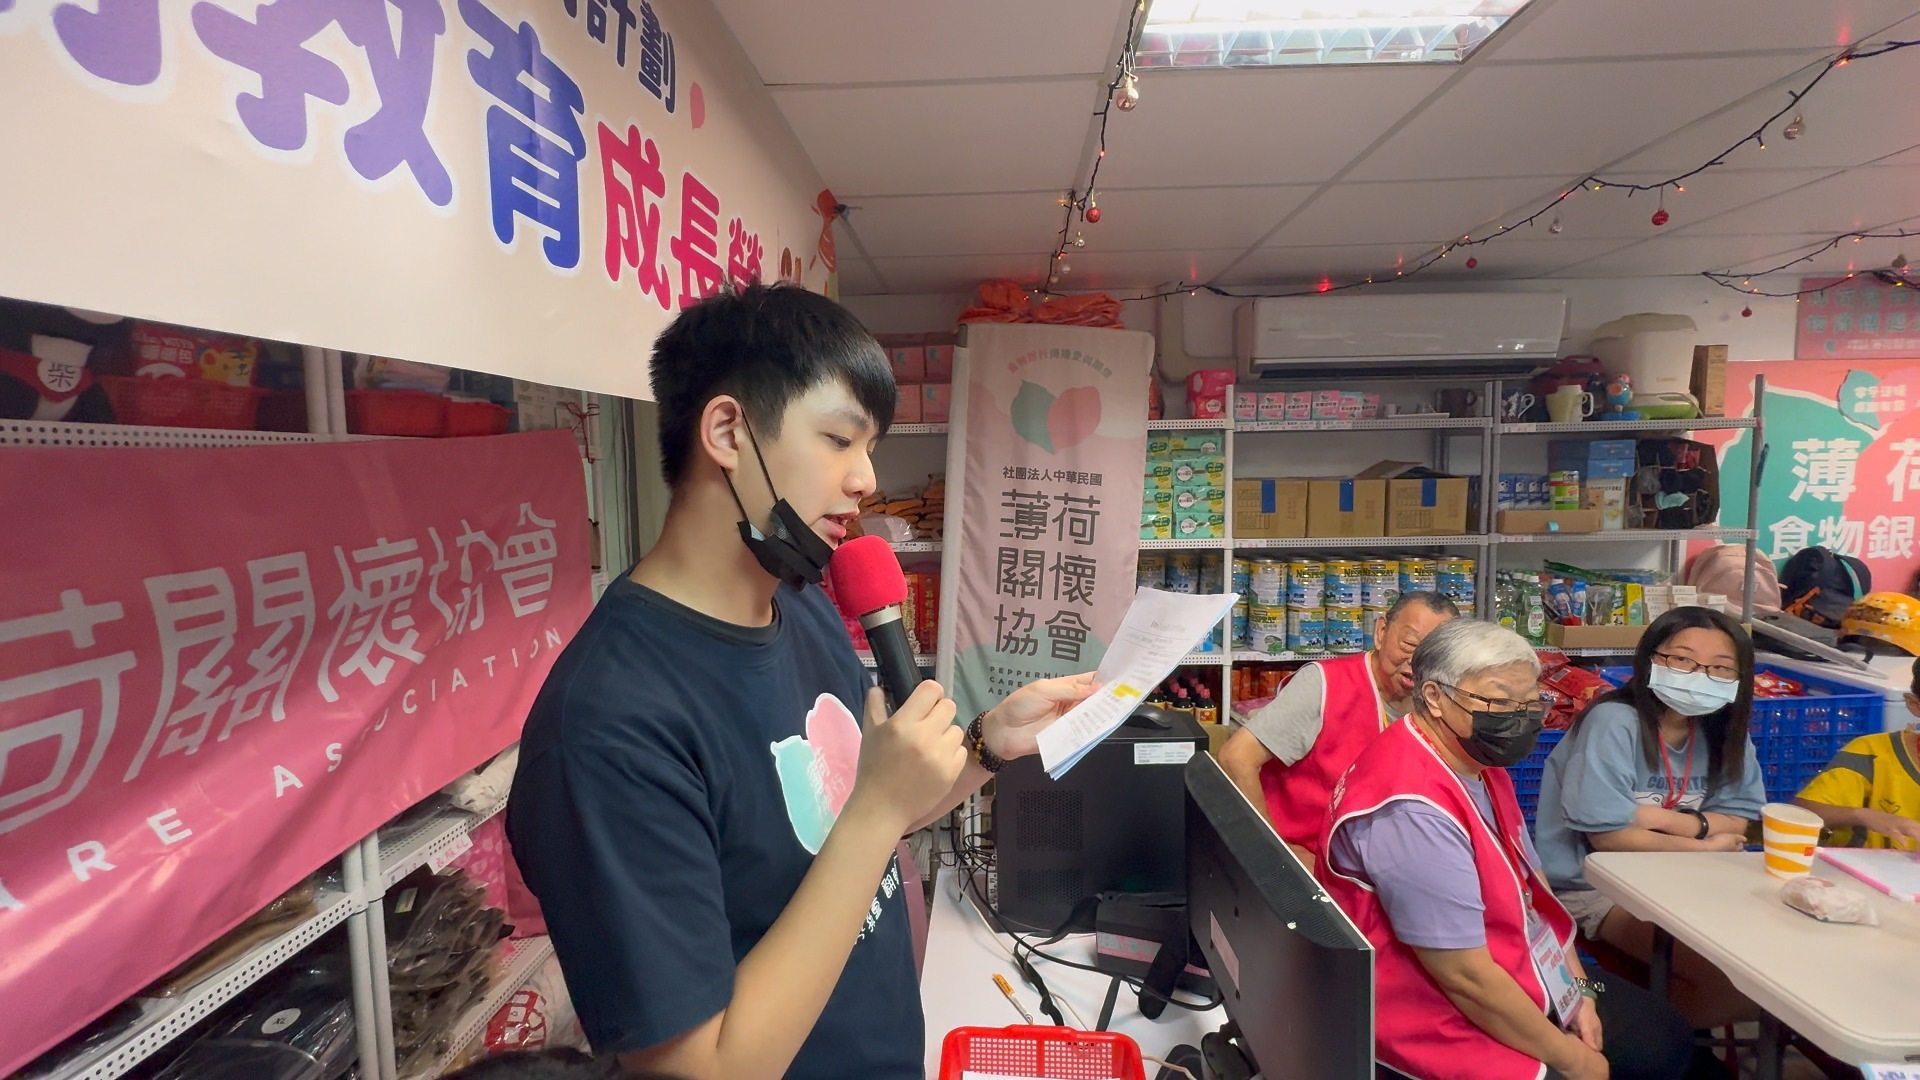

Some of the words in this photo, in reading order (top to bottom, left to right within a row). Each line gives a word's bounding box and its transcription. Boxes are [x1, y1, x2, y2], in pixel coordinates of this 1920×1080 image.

[564, 0, 676, 113] 計劃
[48, 363, 75, 388] 柴
[1003, 466, 1102, 486] 社團法人中華民國
[1000, 489, 1101, 545] 薄荷
[1768, 515, 1920, 560] 食物銀
[996, 546, 1097, 607] 關懷
[994, 604, 1091, 662] 協會
[990, 666, 1064, 679] PEPPERMI
[990, 677, 1023, 688] CARE
